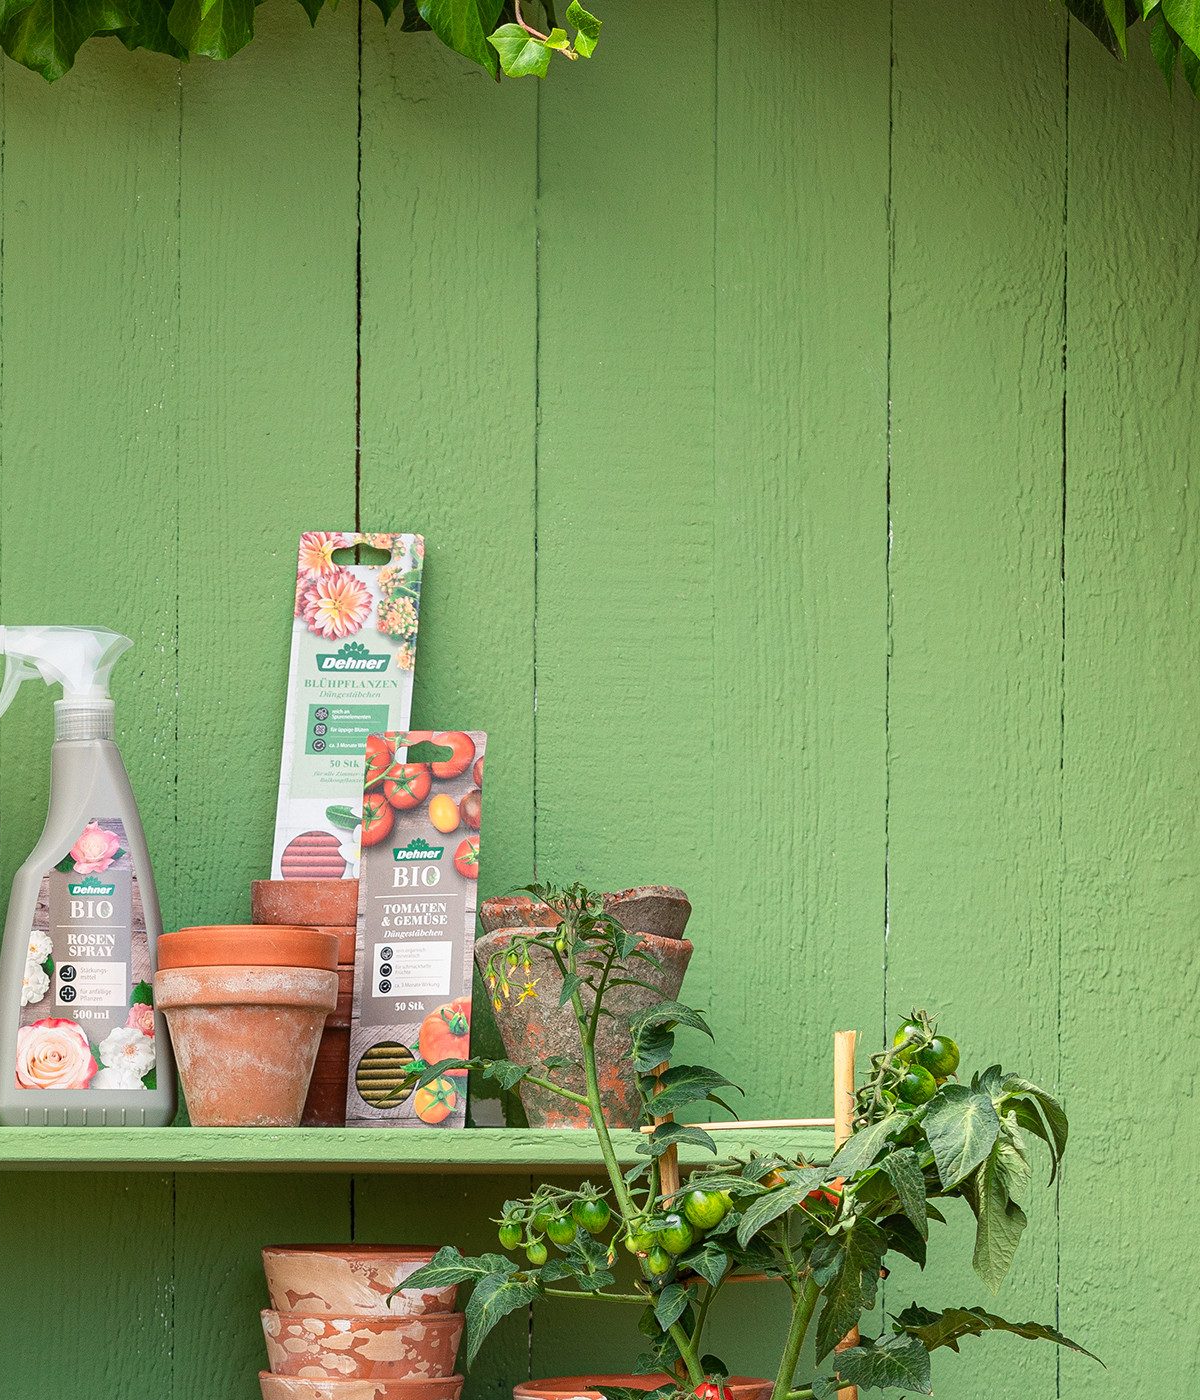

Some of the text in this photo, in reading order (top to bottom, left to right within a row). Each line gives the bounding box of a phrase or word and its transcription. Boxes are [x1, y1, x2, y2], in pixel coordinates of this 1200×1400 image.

[322, 658, 386, 669] Dehner
[304, 678, 398, 688] BLÜHPFLANZEN
[319, 690, 380, 699] Düngestäbchen
[330, 760, 359, 768] 50 Stk
[397, 850, 441, 860] Dehner
[392, 866, 441, 888] BIO
[73, 886, 112, 894] Dehner
[69, 901, 113, 919] BIO
[383, 903, 446, 914] TOMATEN
[381, 913, 448, 926] & GEMÜSE
[67, 934, 116, 945] ROSEN
[384, 930, 443, 939] Düngestäbchen
[69, 946, 114, 957] SPRAY
[395, 1001, 424, 1011] 50 Stk
[73, 1010, 109, 1019] 500 ml
